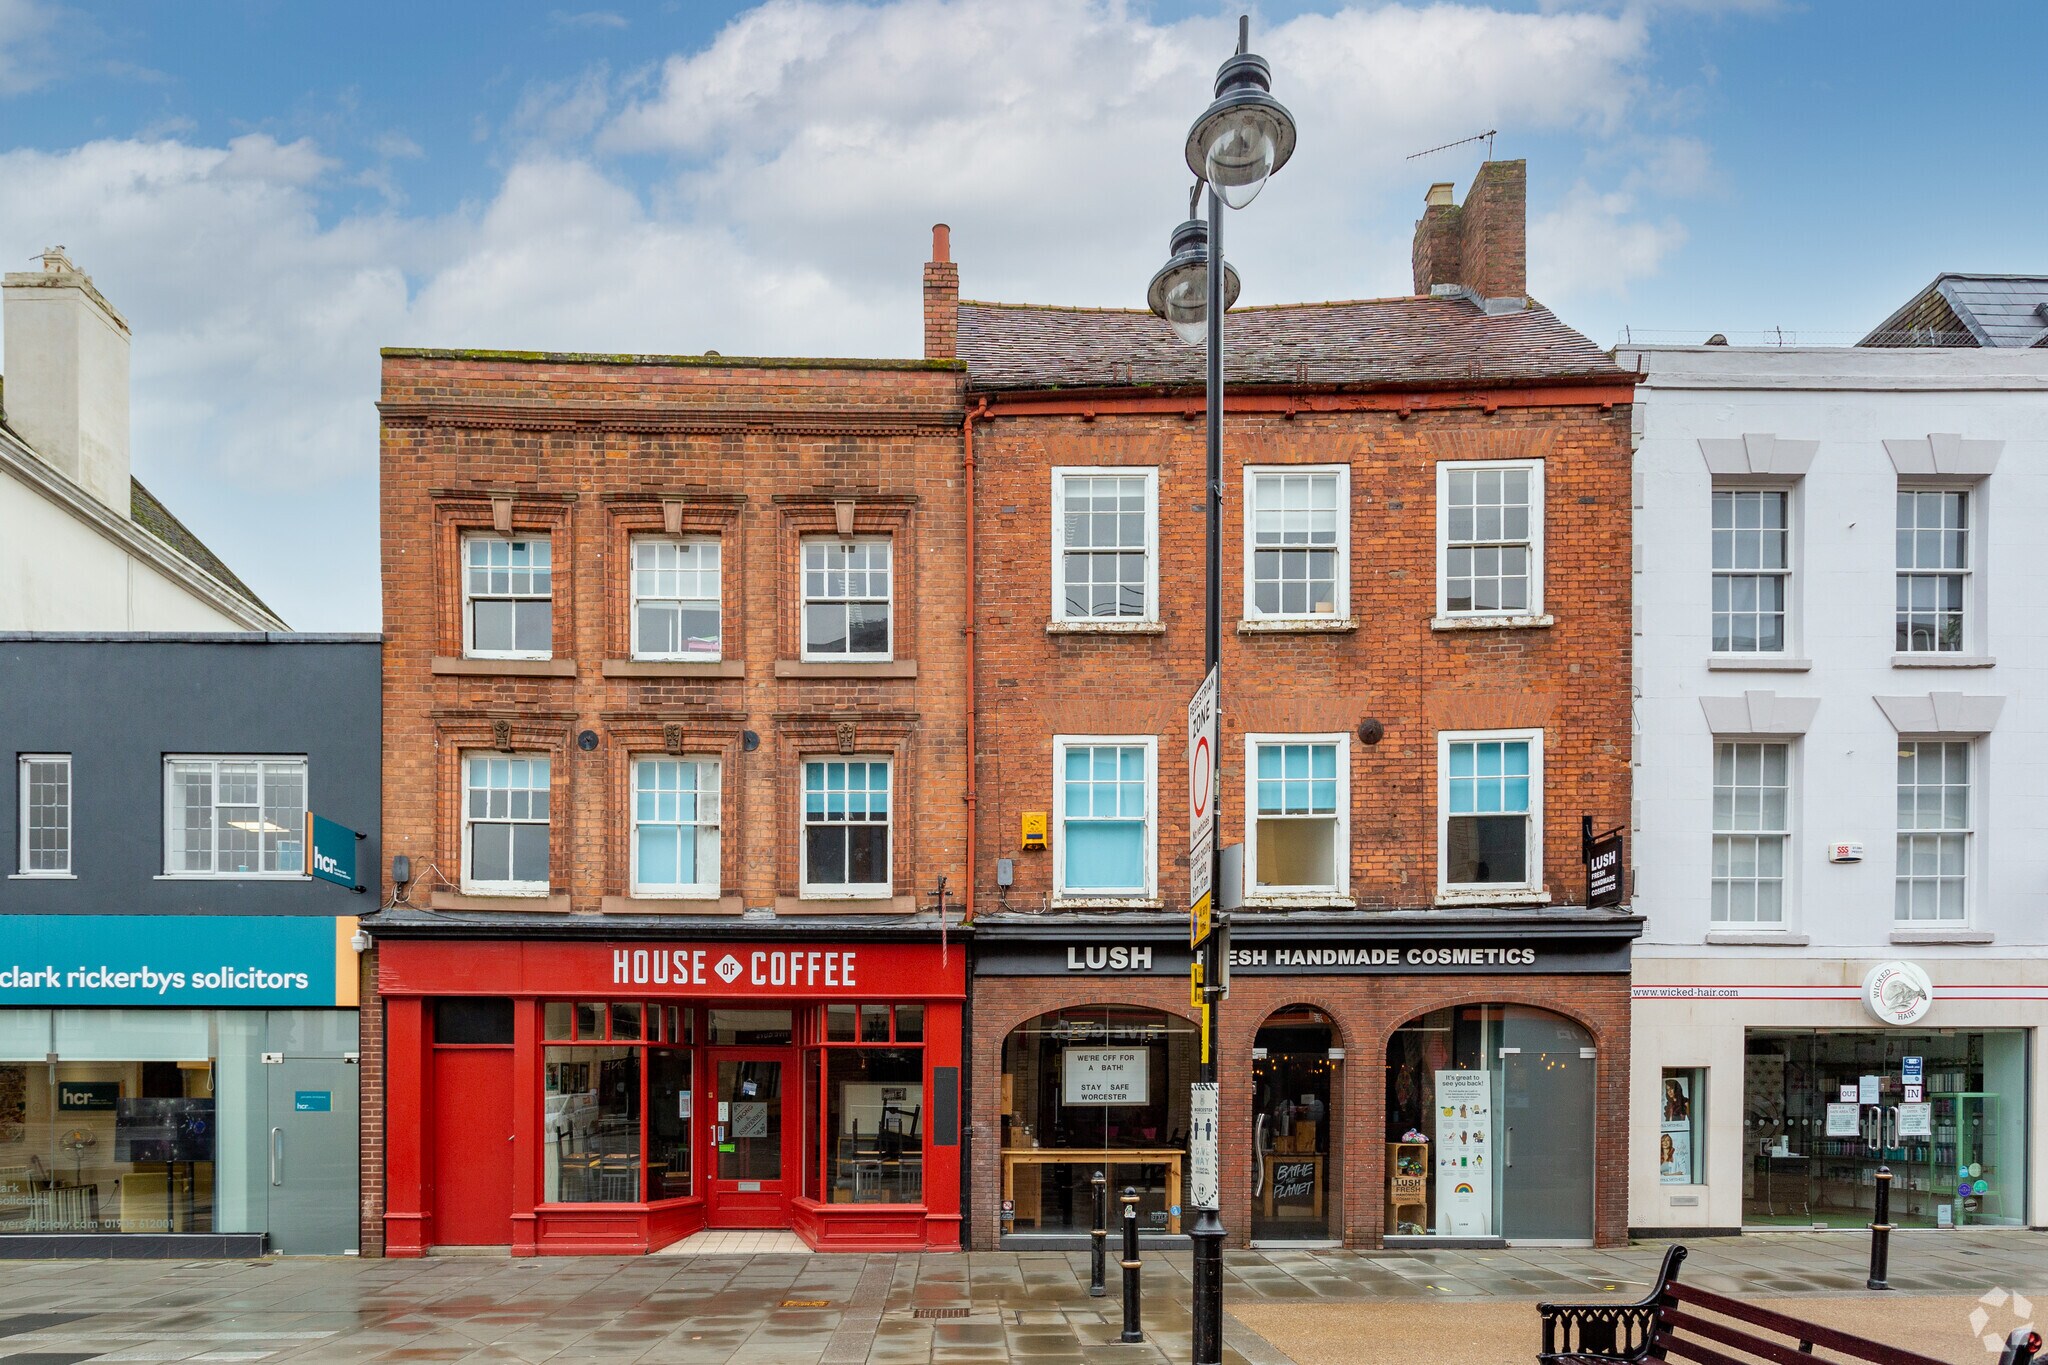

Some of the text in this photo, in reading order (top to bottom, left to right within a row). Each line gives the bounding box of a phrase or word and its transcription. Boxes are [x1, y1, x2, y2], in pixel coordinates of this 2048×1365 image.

[1190, 674, 1214, 719] PEDESTRIAN
[1193, 699, 1210, 739] ZONE
[314, 845, 337, 874] hcr
[1591, 851, 1616, 871] LUSH
[1592, 869, 1606, 880] FRESH
[1592, 874, 1616, 889] HANDMADE
[1592, 883, 1616, 897] COSMETICS
[1067, 946, 1153, 970] LUSH
[1275, 948, 1400, 966] HANDMADE
[1406, 947, 1536, 965] COSMETICS
[613, 949, 857, 986] HOUSE OF COFFEE
[0, 965, 309, 995] clark rickerbys solicitors
[1873, 968, 1891, 999] WICKED
[1633, 987, 1739, 997] www.wicked-hair.com
[1897, 1010, 1916, 1020] HAIR
[1077, 1054, 1099, 1062] WE'RE
[1120, 1054, 1135, 1062] FOR
[1101, 1064, 1124, 1072] BATH!
[1110, 1083, 1130, 1091] SAFE
[1907, 1089, 1919, 1098] IN
[62, 1087, 93, 1105] hcr
[1081, 1093, 1127, 1101] WORCESTER
[1276, 1163, 1314, 1180] BATHE
[1273, 1180, 1314, 1199] PLANET
[1396, 1179, 1421, 1187] LUSH
[139, 1219, 174, 1229] 612001
